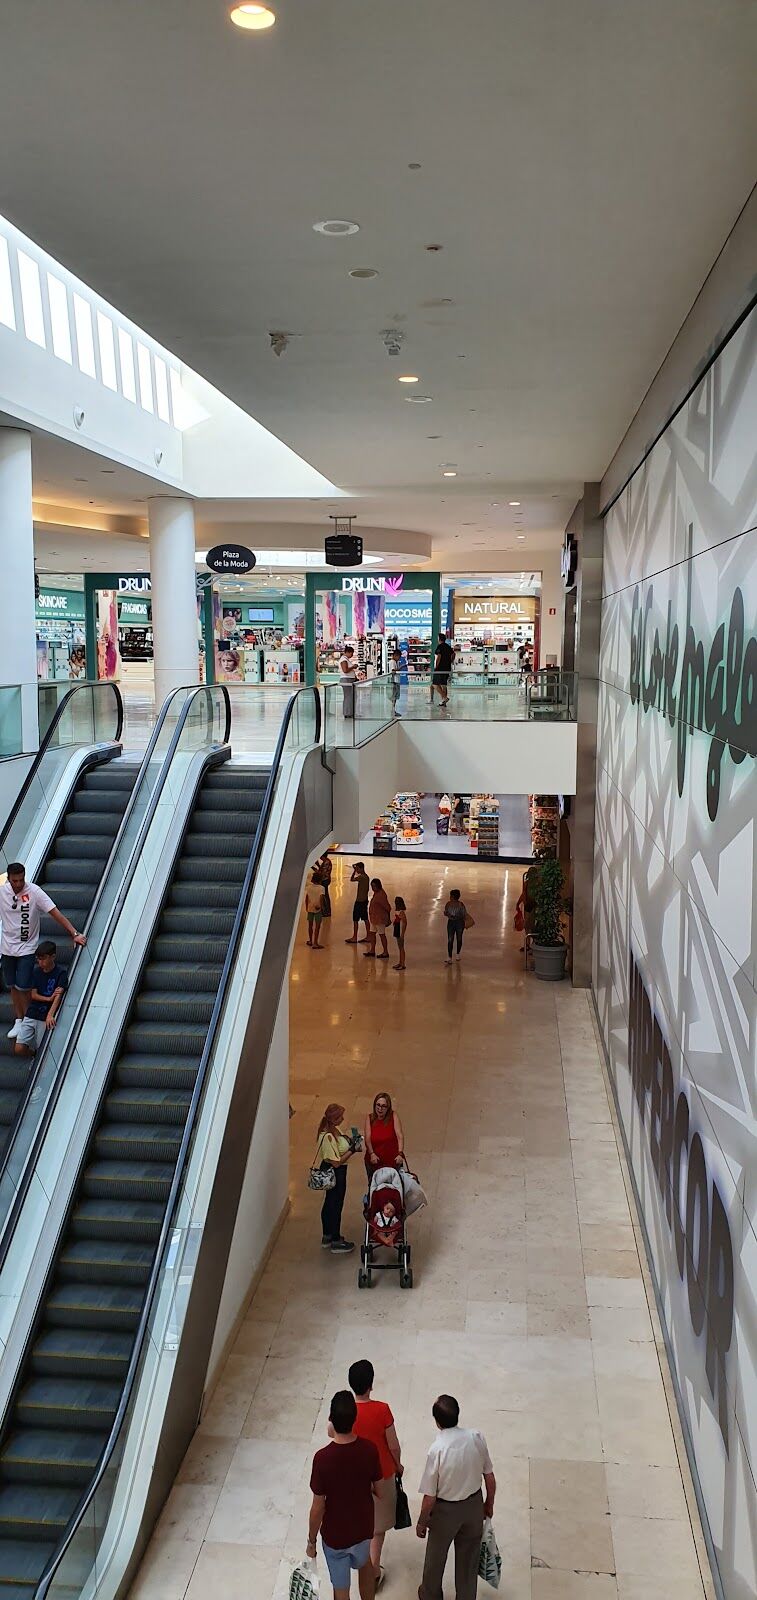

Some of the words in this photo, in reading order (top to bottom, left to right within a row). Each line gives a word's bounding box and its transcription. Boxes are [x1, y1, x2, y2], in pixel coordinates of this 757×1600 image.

[230, 560, 249, 568] Moda
[342, 577, 386, 592] DRUNI
[38, 594, 68, 609] SKINCARE
[464, 603, 525, 614] NATURAL
[642, 584, 679, 728] Corte
[20, 913, 29, 925] DO
[627, 948, 735, 1462] HIPERCOR
